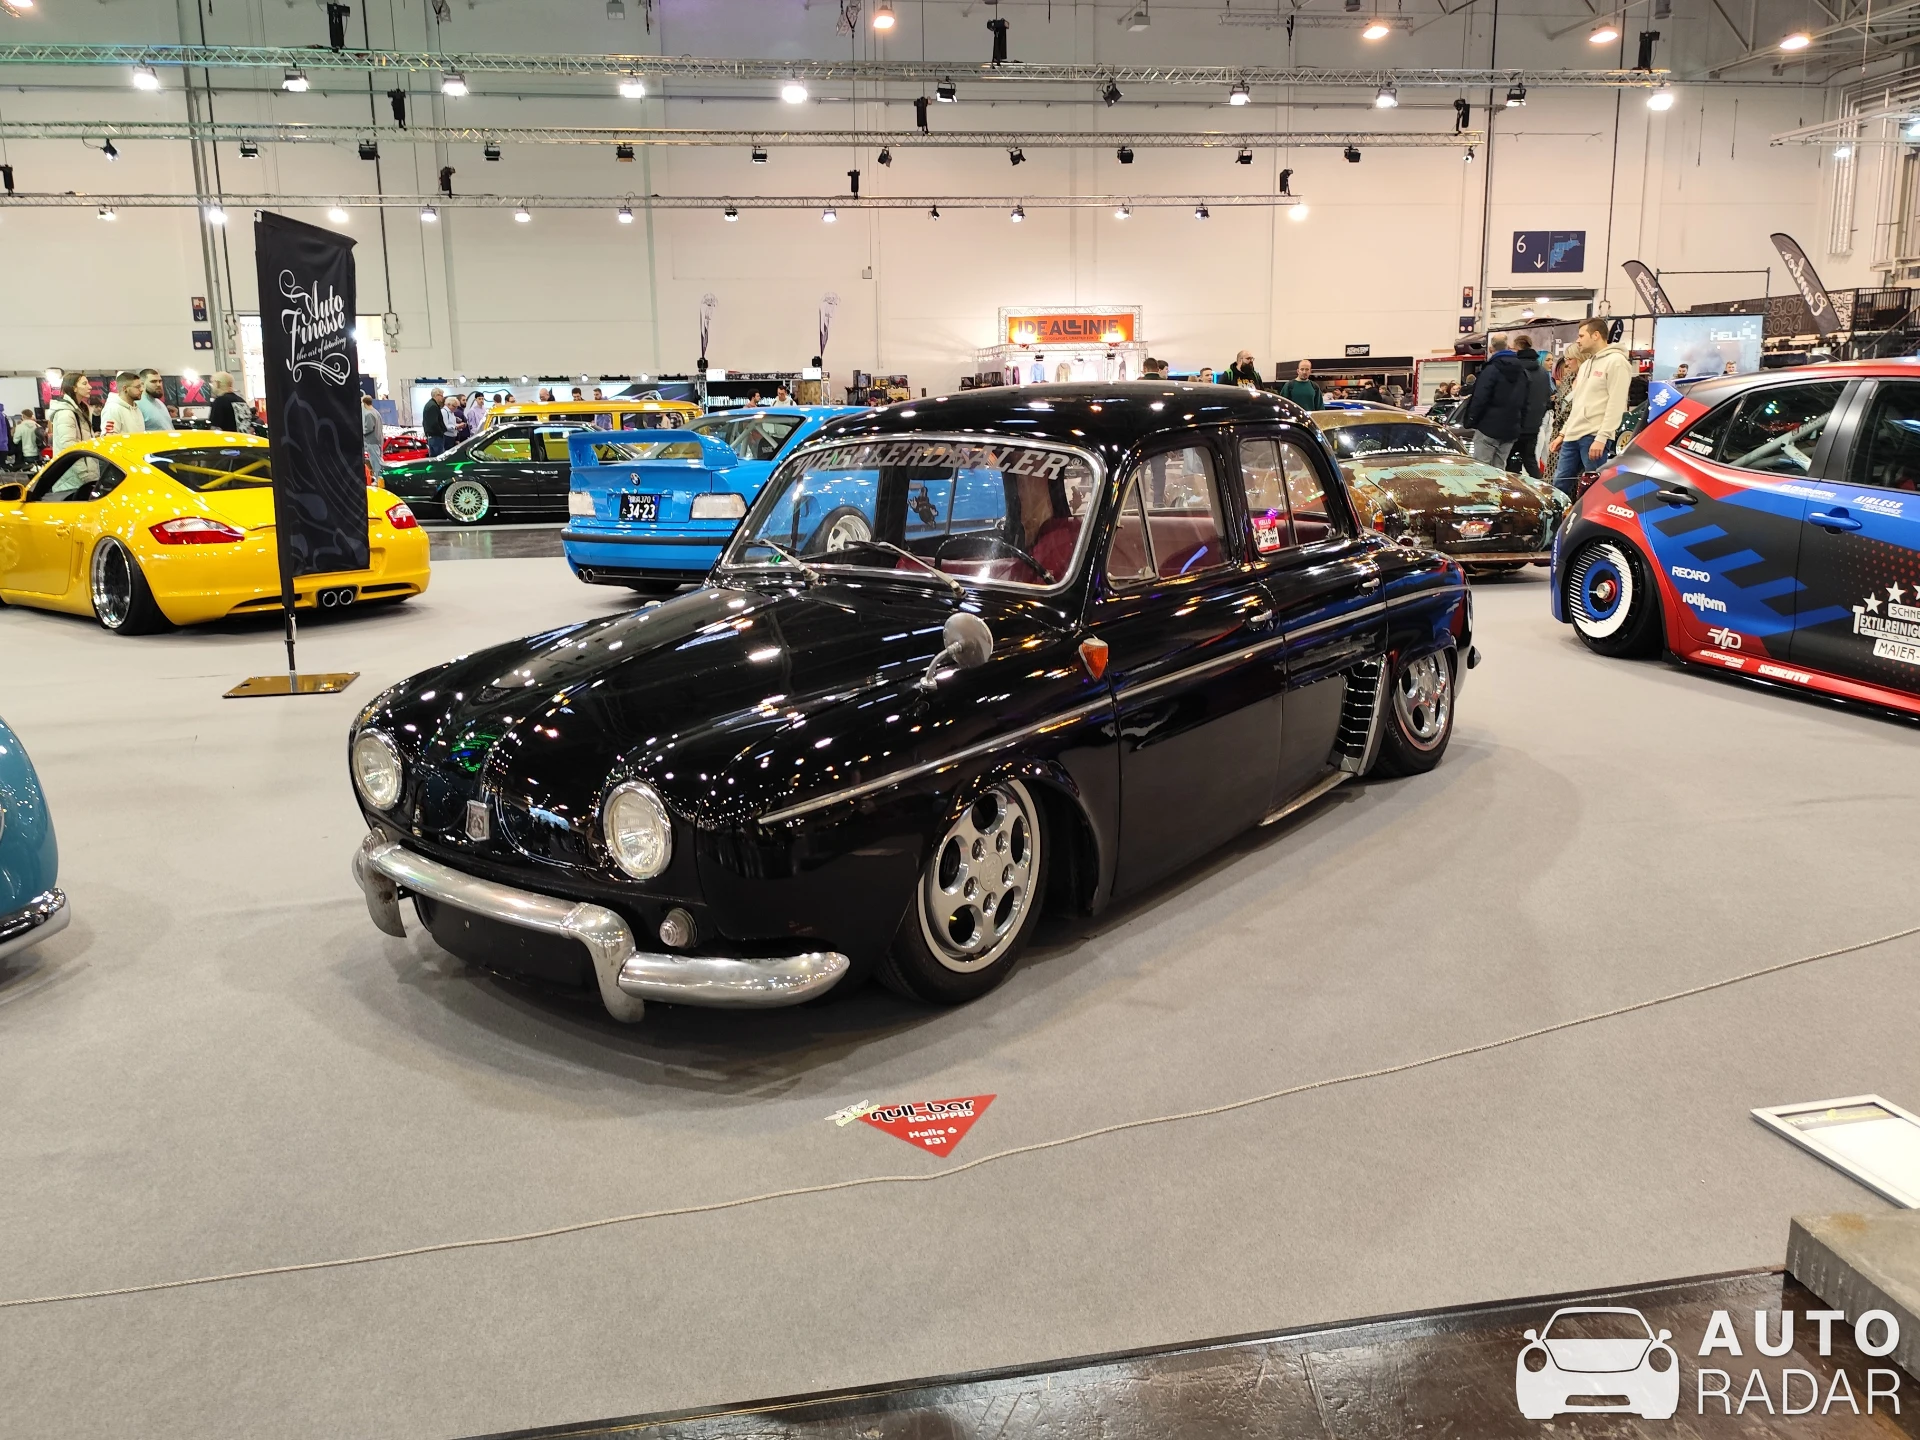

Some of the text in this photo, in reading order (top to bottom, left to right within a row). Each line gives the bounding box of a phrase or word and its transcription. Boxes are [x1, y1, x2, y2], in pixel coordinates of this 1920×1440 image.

[1516, 234, 1527, 254] 6
[290, 276, 344, 326] Auto
[1763, 316, 1803, 336] 2026
[281, 307, 346, 368] Finesse
[1852, 495, 1904, 509] AIRLESS
[1606, 504, 1635, 519] CUSCO
[1672, 565, 1710, 583] RECARO
[1682, 592, 1727, 613] rotiform
[907, 1110, 975, 1123] EQUIPPED
[908, 1127, 958, 1139] Halle 6
[924, 1136, 947, 1146] E31
